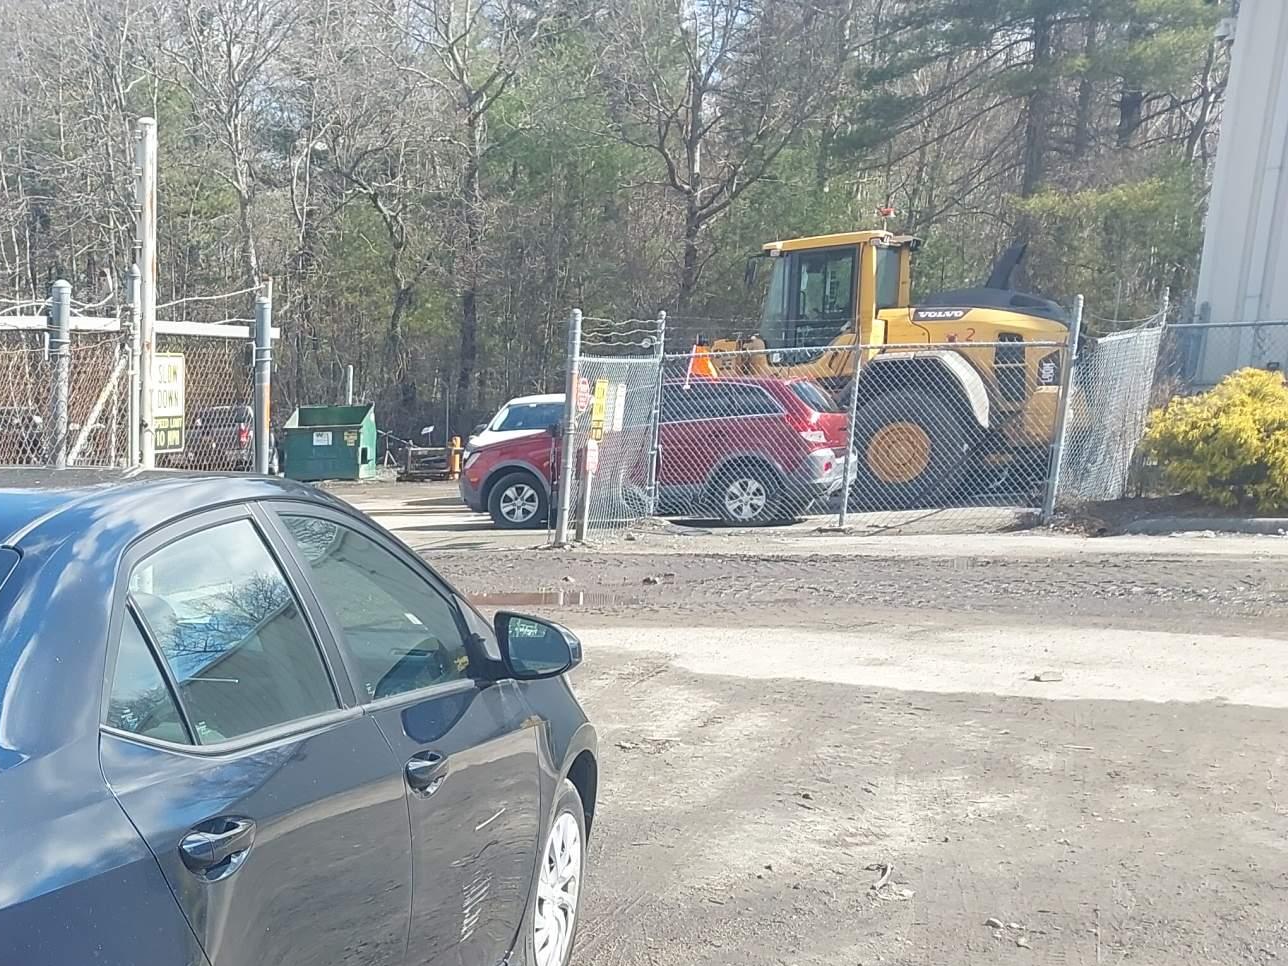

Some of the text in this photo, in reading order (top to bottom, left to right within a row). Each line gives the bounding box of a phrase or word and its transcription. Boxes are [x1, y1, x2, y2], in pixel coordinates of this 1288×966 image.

[918, 310, 964, 318] VOLVO
[158, 364, 178, 384] SLOW
[157, 389, 179, 408] DOWN
[156, 430, 166, 447] 10
